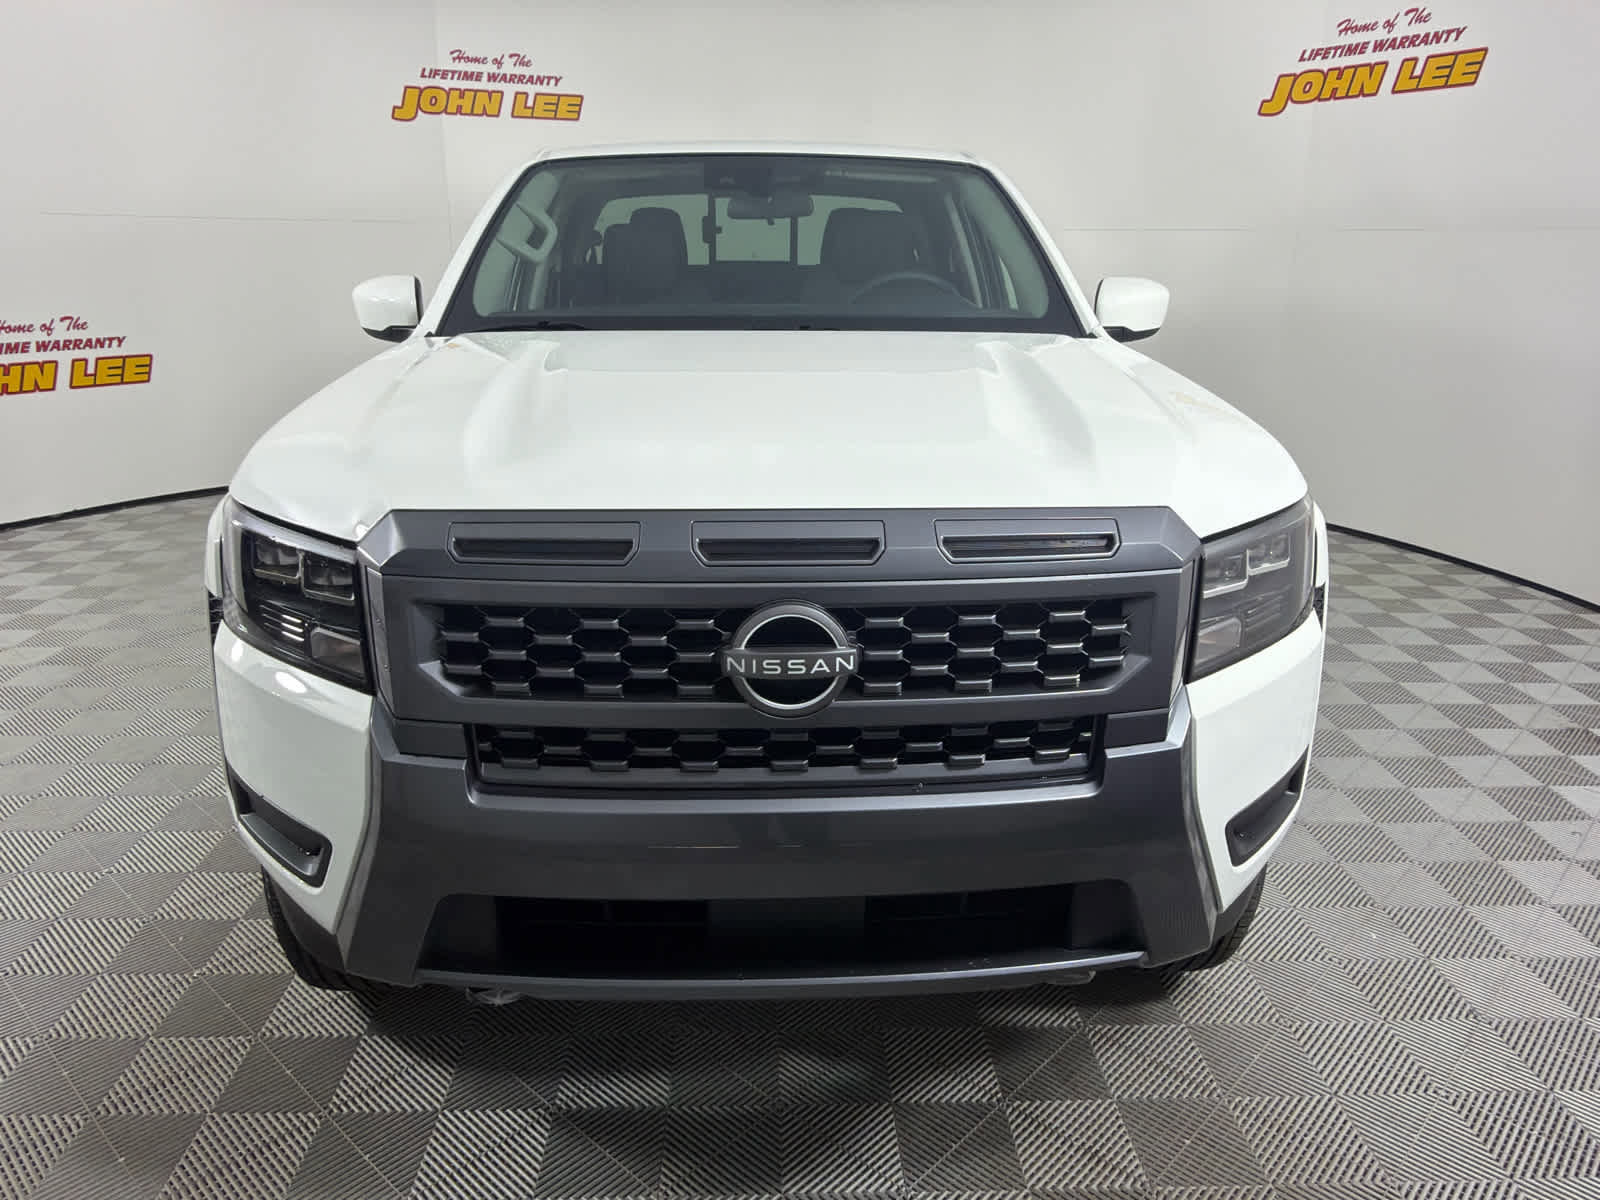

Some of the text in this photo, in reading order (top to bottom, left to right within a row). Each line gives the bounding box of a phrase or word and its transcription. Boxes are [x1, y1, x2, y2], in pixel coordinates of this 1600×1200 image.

[1336, 7, 1432, 37] Home of The
[1298, 25, 1468, 62] LIFETIME WARRANTY
[449, 49, 532, 69] Home of The
[419, 67, 562, 87] LIFETIME WARRANTY
[1257, 46, 1488, 117] JOHN LEE
[391, 85, 584, 121] JOHN LEE
[39, 318, 55, 336] of
[59, 315, 89, 332] The
[35, 335, 126, 353] WARRANTY
[69, 353, 153, 389] LEE
[726, 655, 854, 675] NISSAN
